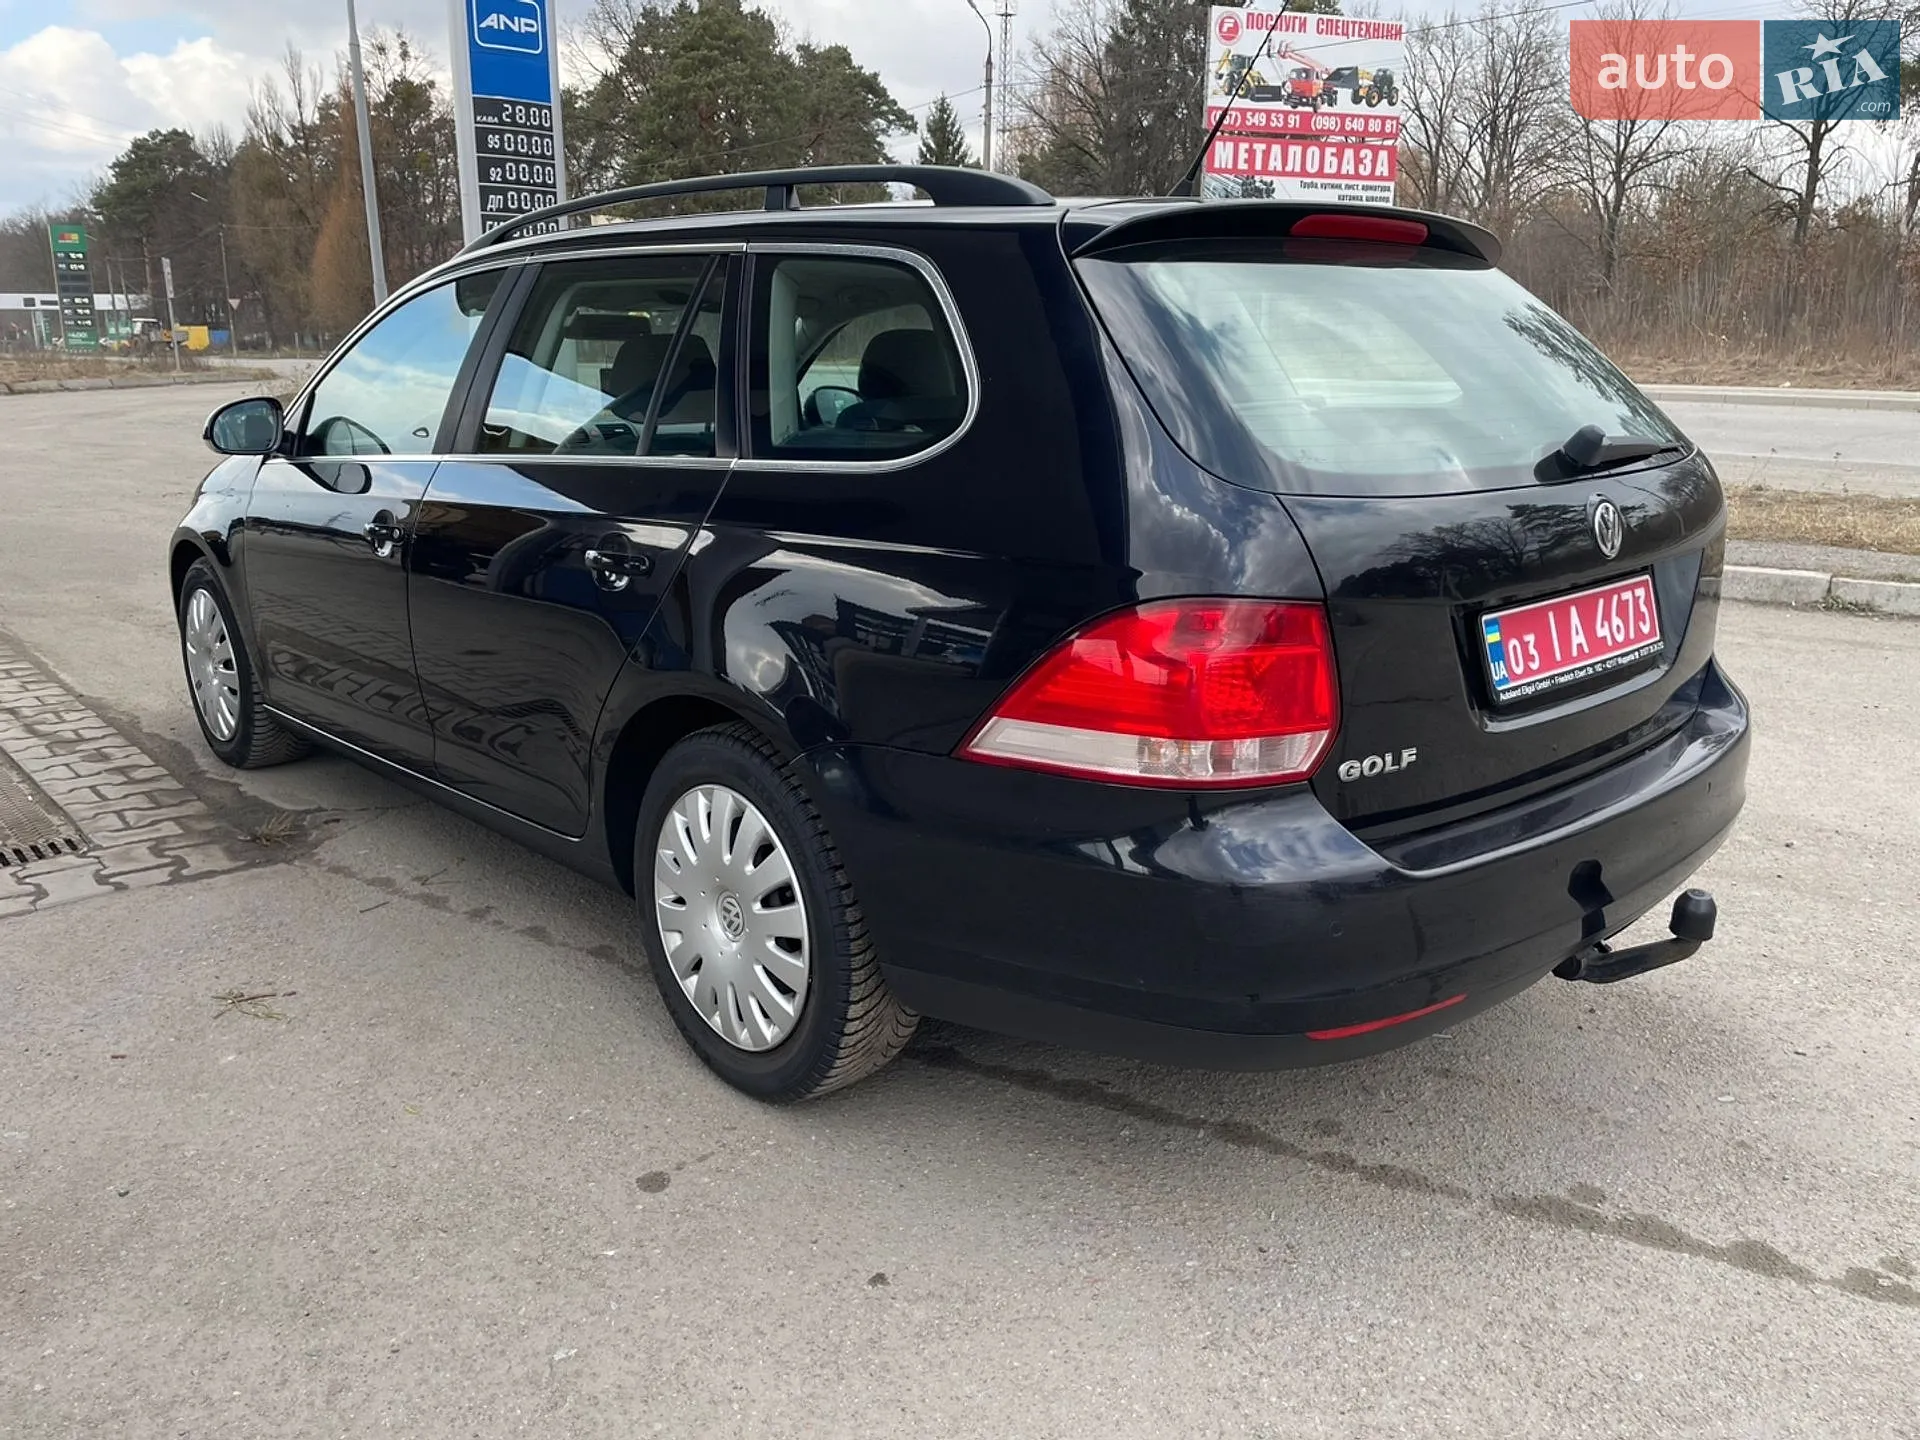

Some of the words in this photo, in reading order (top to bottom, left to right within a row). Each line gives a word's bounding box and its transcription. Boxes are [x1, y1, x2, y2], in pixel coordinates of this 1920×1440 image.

[479, 13, 538, 33] ANP
[1246, 12, 1307, 33] ПОСЛУГИ
[1316, 17, 1403, 40] СПЕЦТЕХНІКИ
[502, 103, 551, 127] 28.00
[1245, 111, 1267, 126] 549
[1270, 112, 1284, 128] 53
[1287, 113, 1300, 128] 91
[1311, 114, 1341, 132] (098)
[1345, 116, 1365, 132] 640
[1368, 117, 1382, 133] 80
[1385, 119, 1397, 134] 81
[487, 134, 500, 149] 95
[504, 133, 552, 156] 00.00
[1214, 141, 1389, 177] МЕТАЛОБАЗА
[489, 167, 502, 182] 92
[505, 162, 554, 185] 00.00
[487, 195, 503, 212] ДП
[1490, 661, 1508, 680] UA
[1507, 633, 1540, 675] 03
[1595, 587, 1650, 646] 4673
[1338, 747, 1417, 782] GOLF
